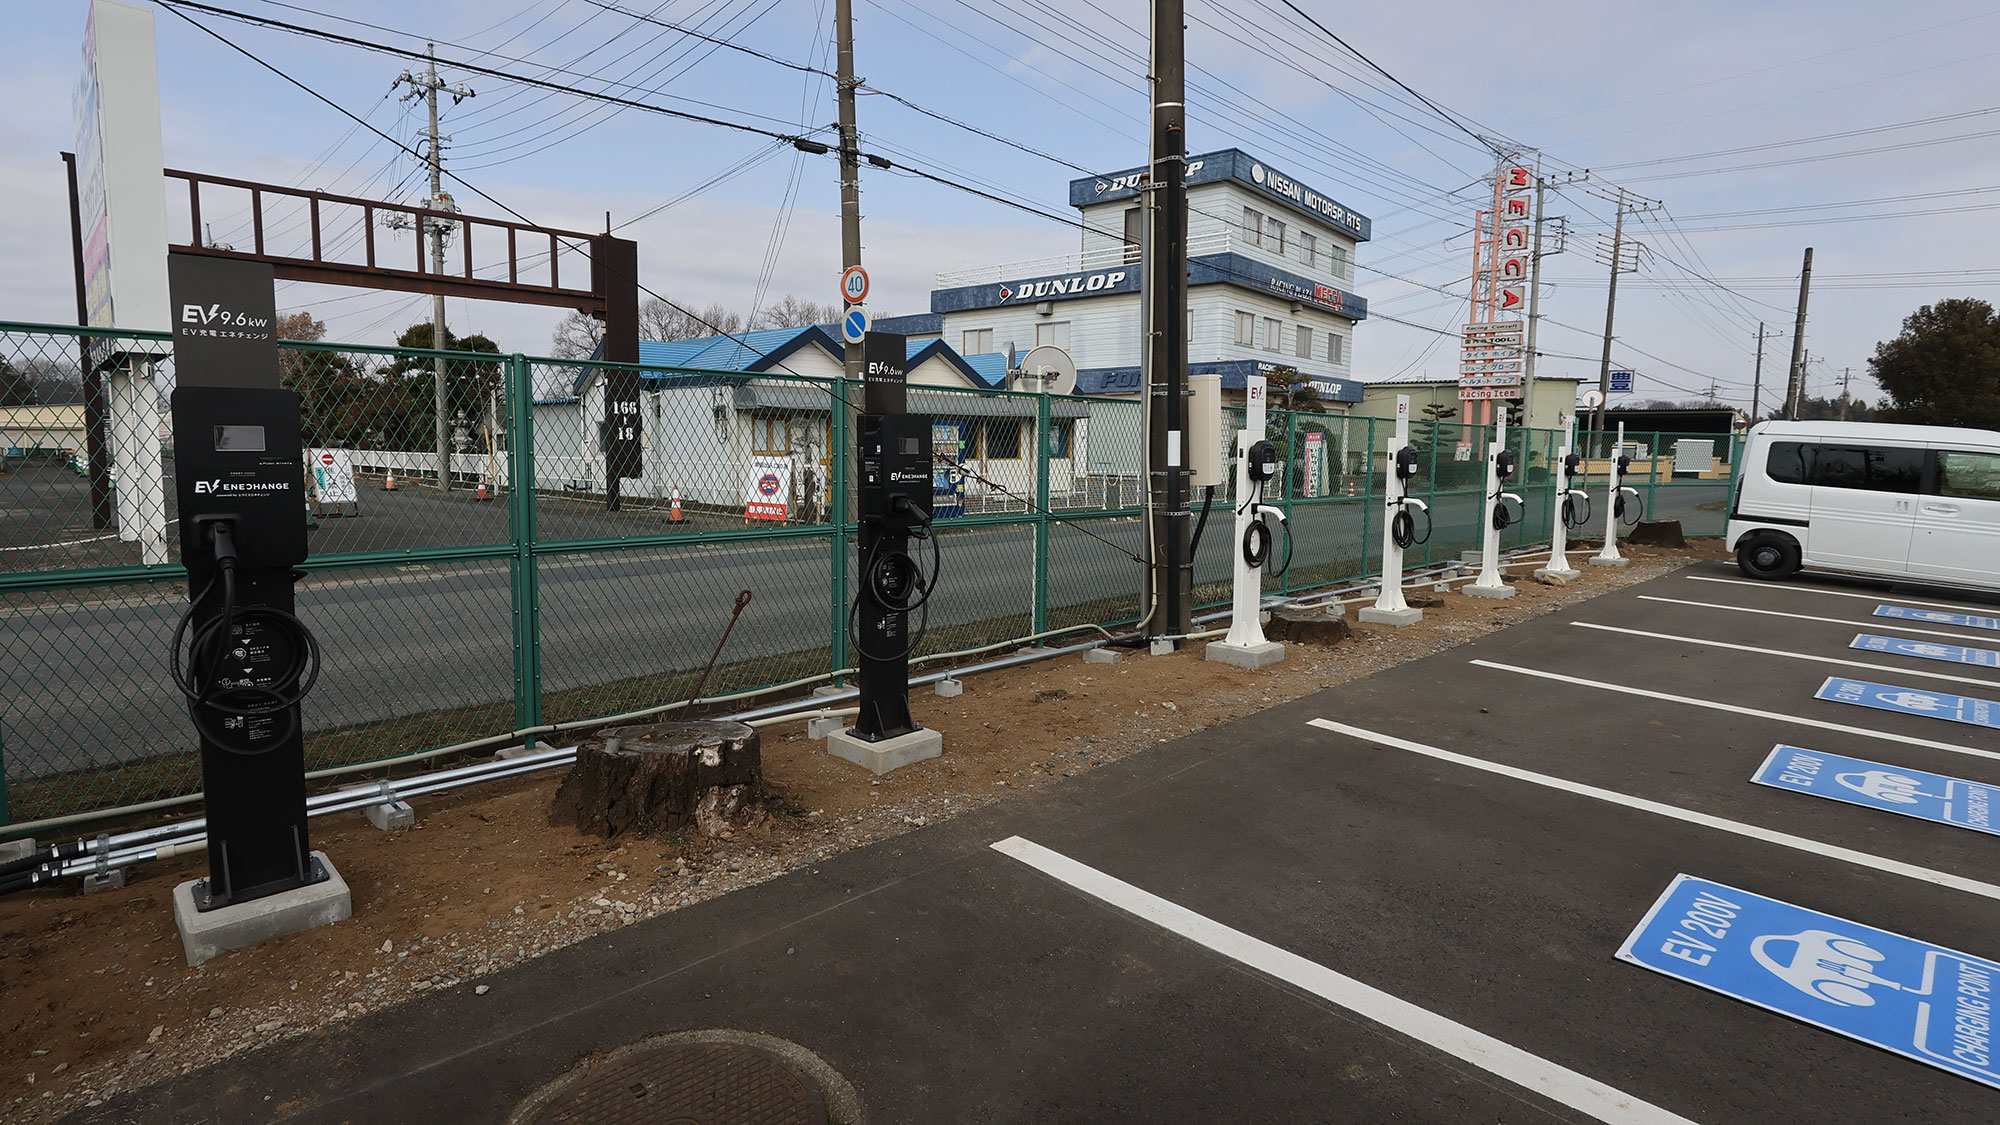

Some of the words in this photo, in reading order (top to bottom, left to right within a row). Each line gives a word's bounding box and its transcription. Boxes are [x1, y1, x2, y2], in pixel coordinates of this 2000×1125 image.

[1109, 161, 1204, 192] DUP
[1267, 171, 1301, 202] NISSAN
[1502, 168, 1528, 308] MECCA
[847, 275, 863, 293] 40
[1016, 271, 1126, 300] DUNLOP
[1313, 283, 1343, 312] MECCA
[182, 303, 220, 325] EV
[869, 361, 884, 375] EV
[1460, 390, 1492, 399] Racing
[1494, 390, 1516, 398] Item
[613, 401, 638, 415] 166
[618, 427, 634, 441] 18
[195, 479, 221, 494] EV
[223, 482, 290, 491] ENECHANGE
[1786, 752, 1825, 776] 200V
[1778, 769, 1813, 787] EV
[1680, 890, 1742, 940] 200V
[1660, 930, 1718, 967] EV
[1957, 962, 1991, 1001] POINT
[1952, 996, 1991, 1067] CHARGING
